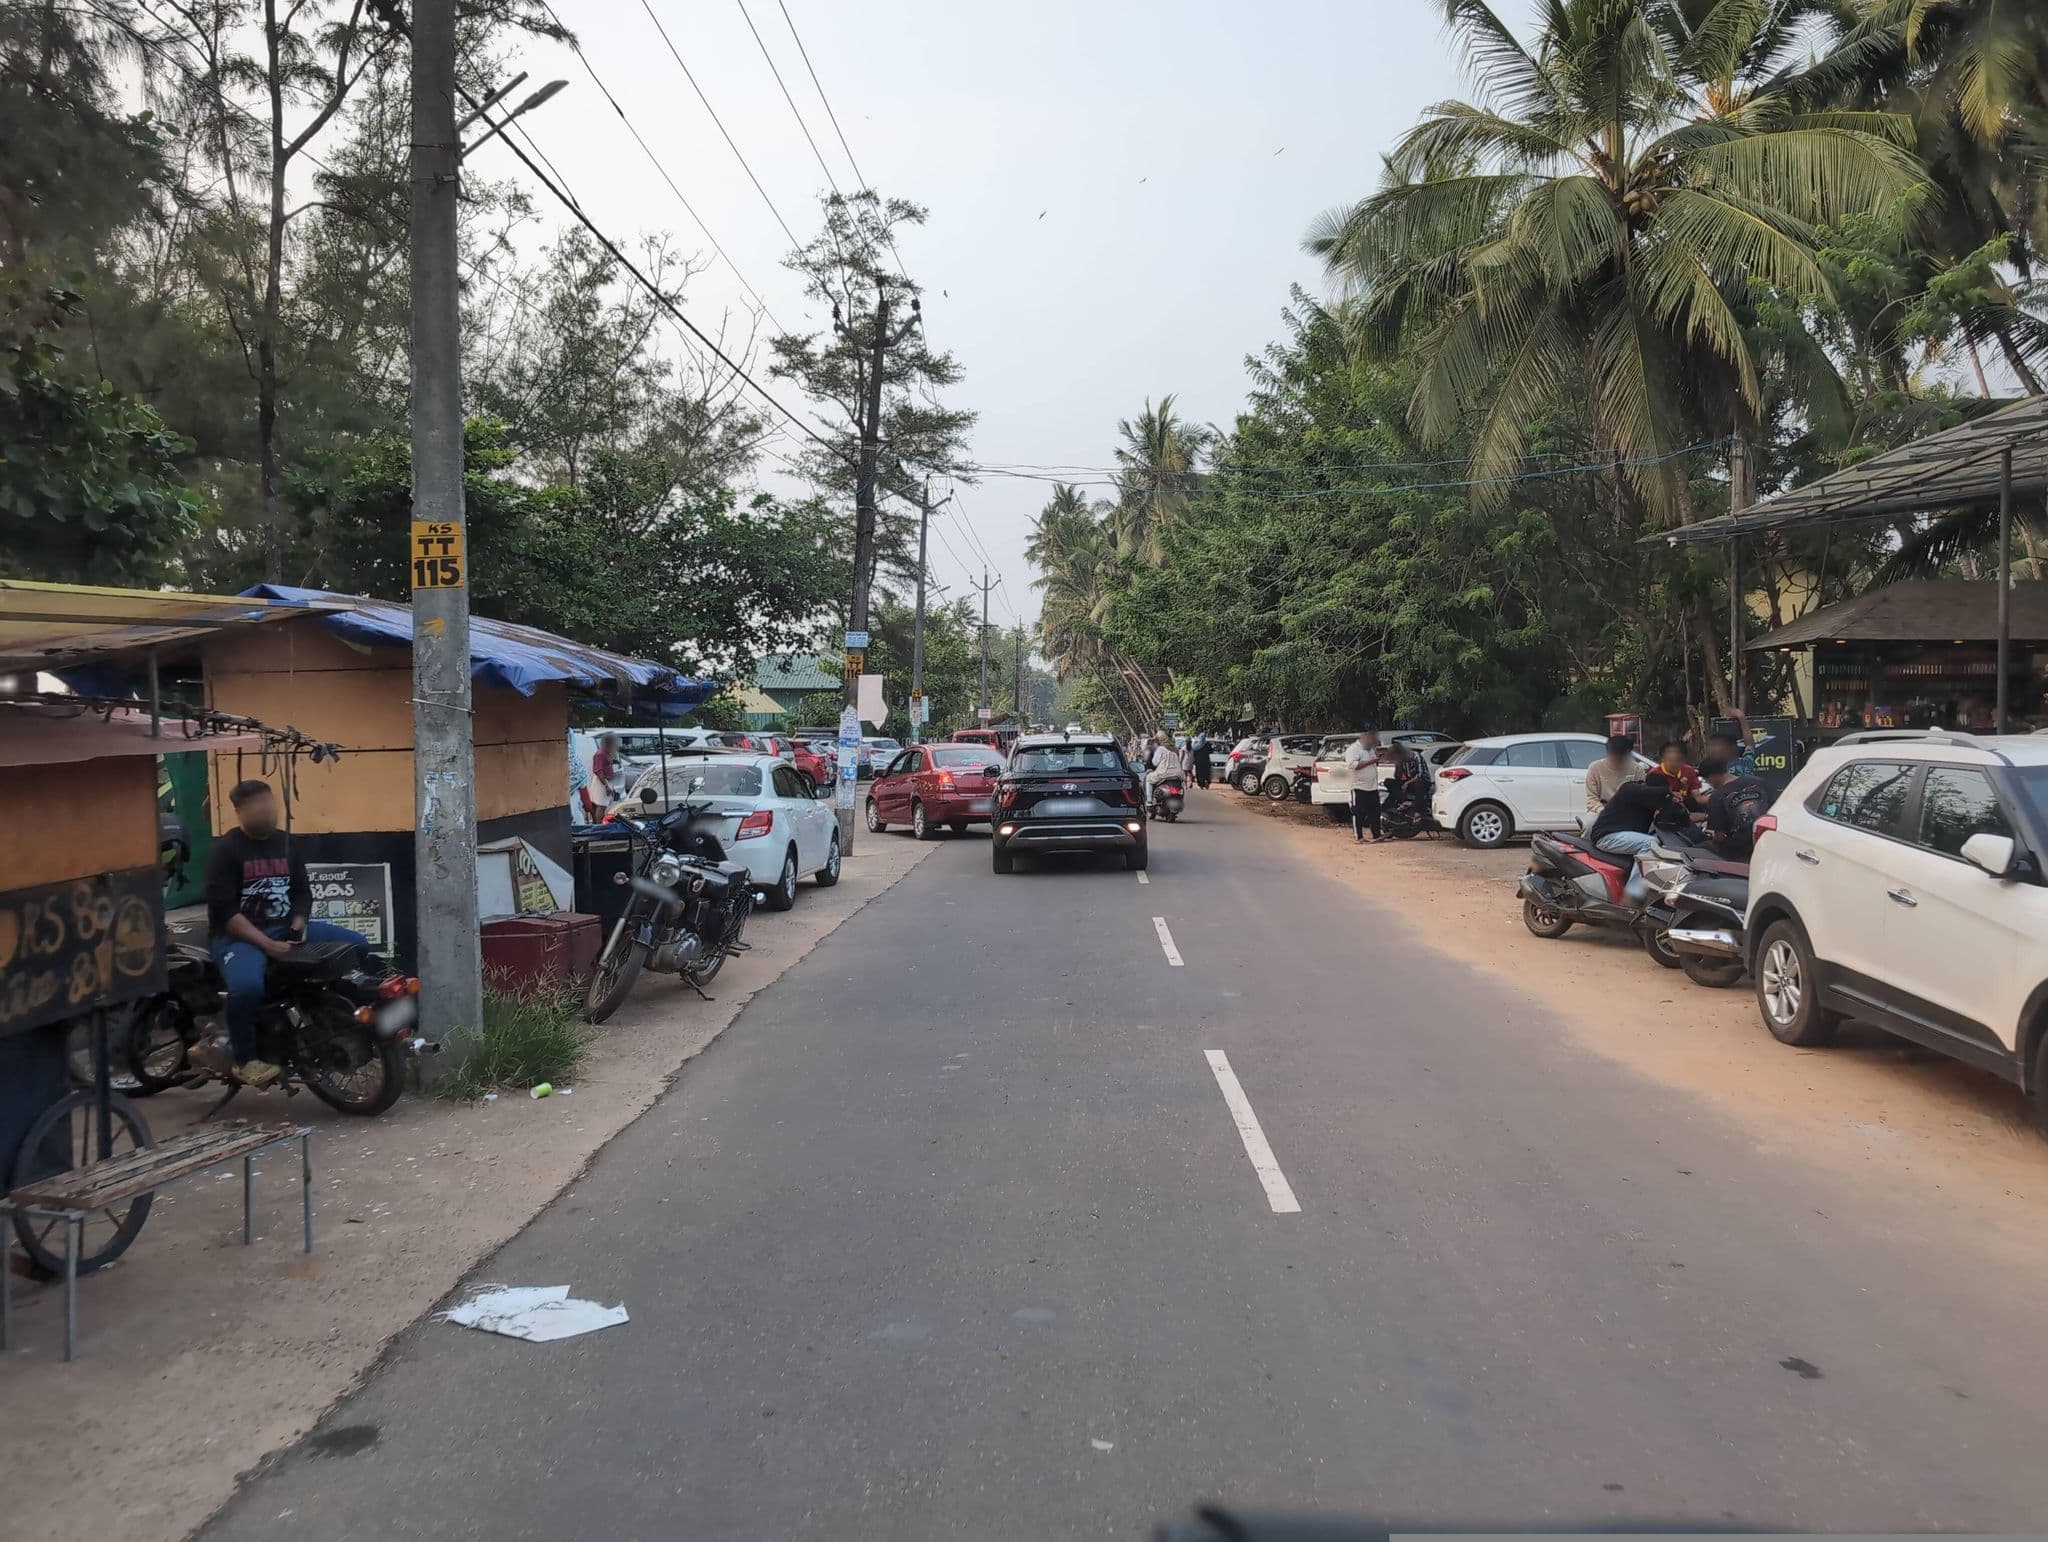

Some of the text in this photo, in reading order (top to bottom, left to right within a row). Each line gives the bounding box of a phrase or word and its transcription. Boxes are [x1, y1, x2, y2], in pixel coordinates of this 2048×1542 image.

[428, 524, 453, 534] KS
[418, 537, 455, 555] TT
[414, 558, 460, 586] 115
